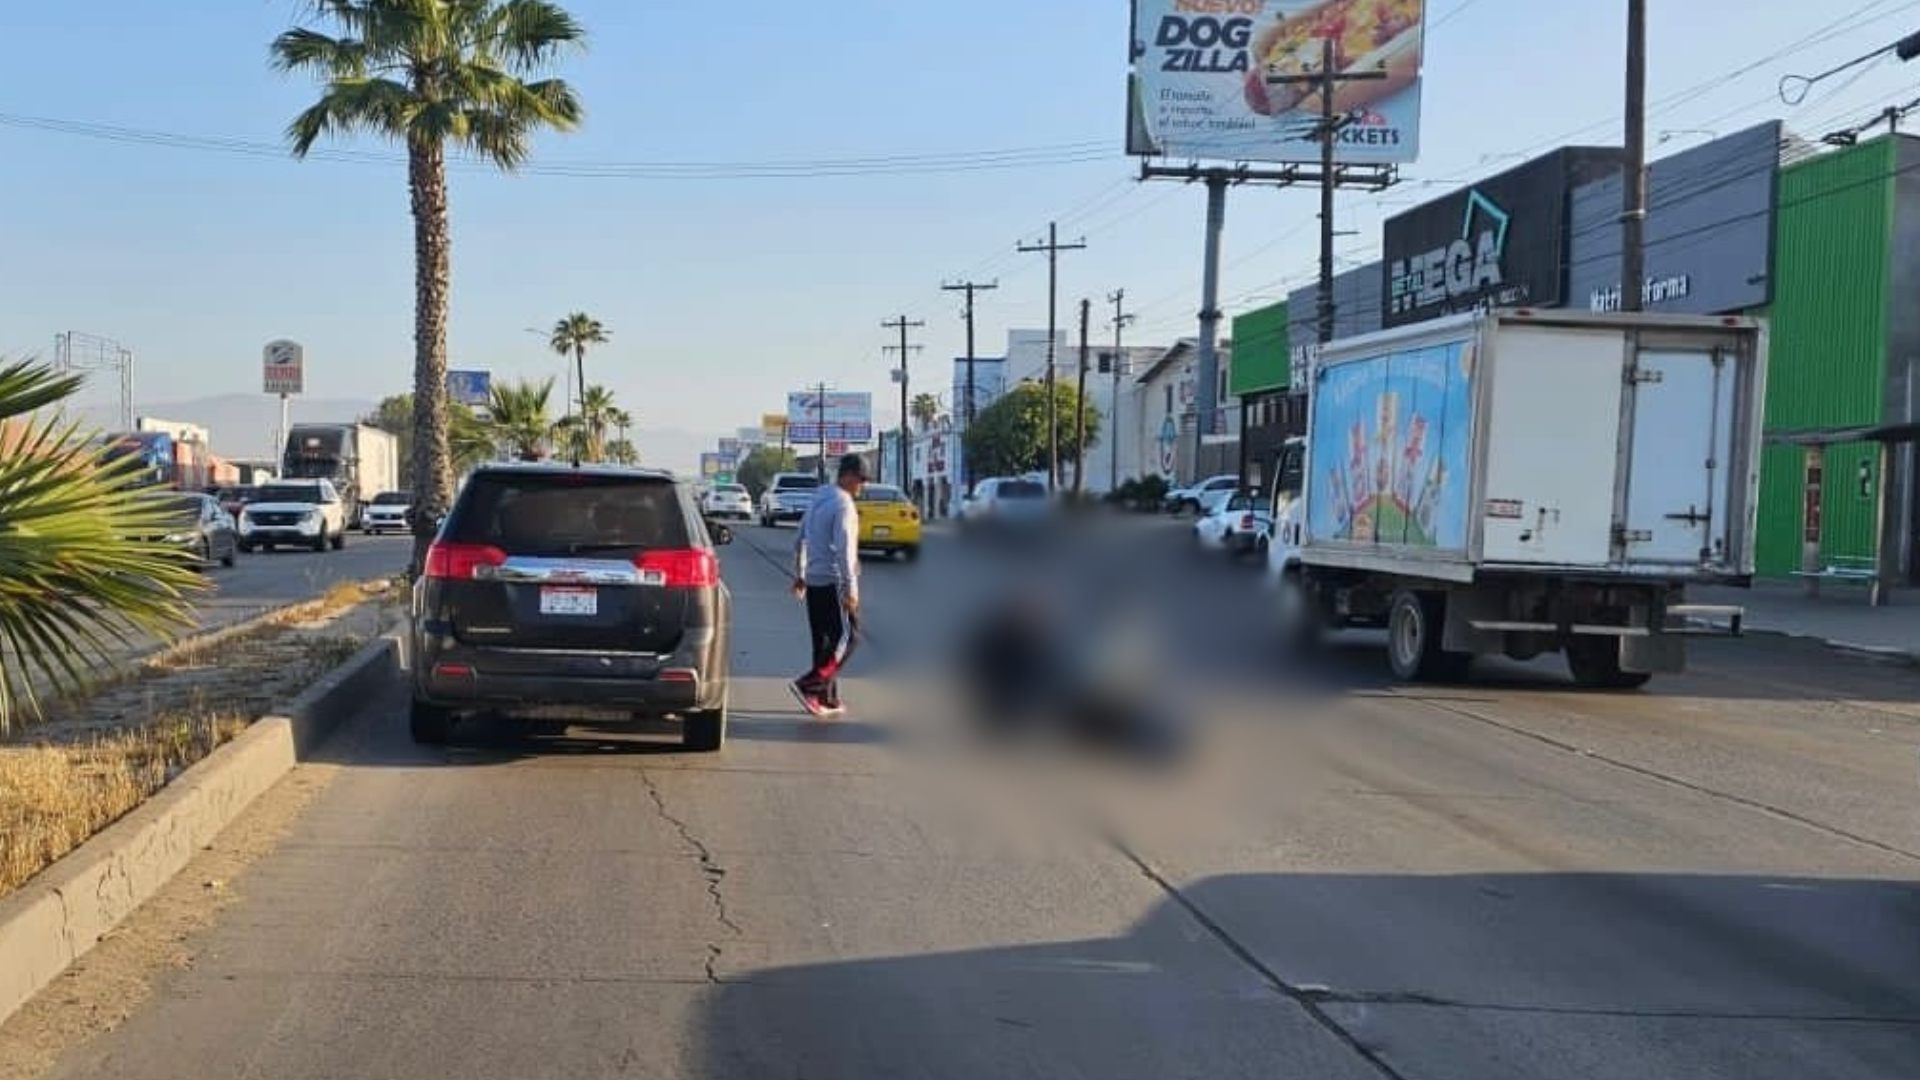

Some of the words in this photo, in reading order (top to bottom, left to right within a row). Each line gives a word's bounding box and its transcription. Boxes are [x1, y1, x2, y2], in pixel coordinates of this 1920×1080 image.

[1155, 16, 1253, 48] DOG
[1161, 49, 1249, 72] ZILLA
[1391, 229, 1501, 313] MEGA
